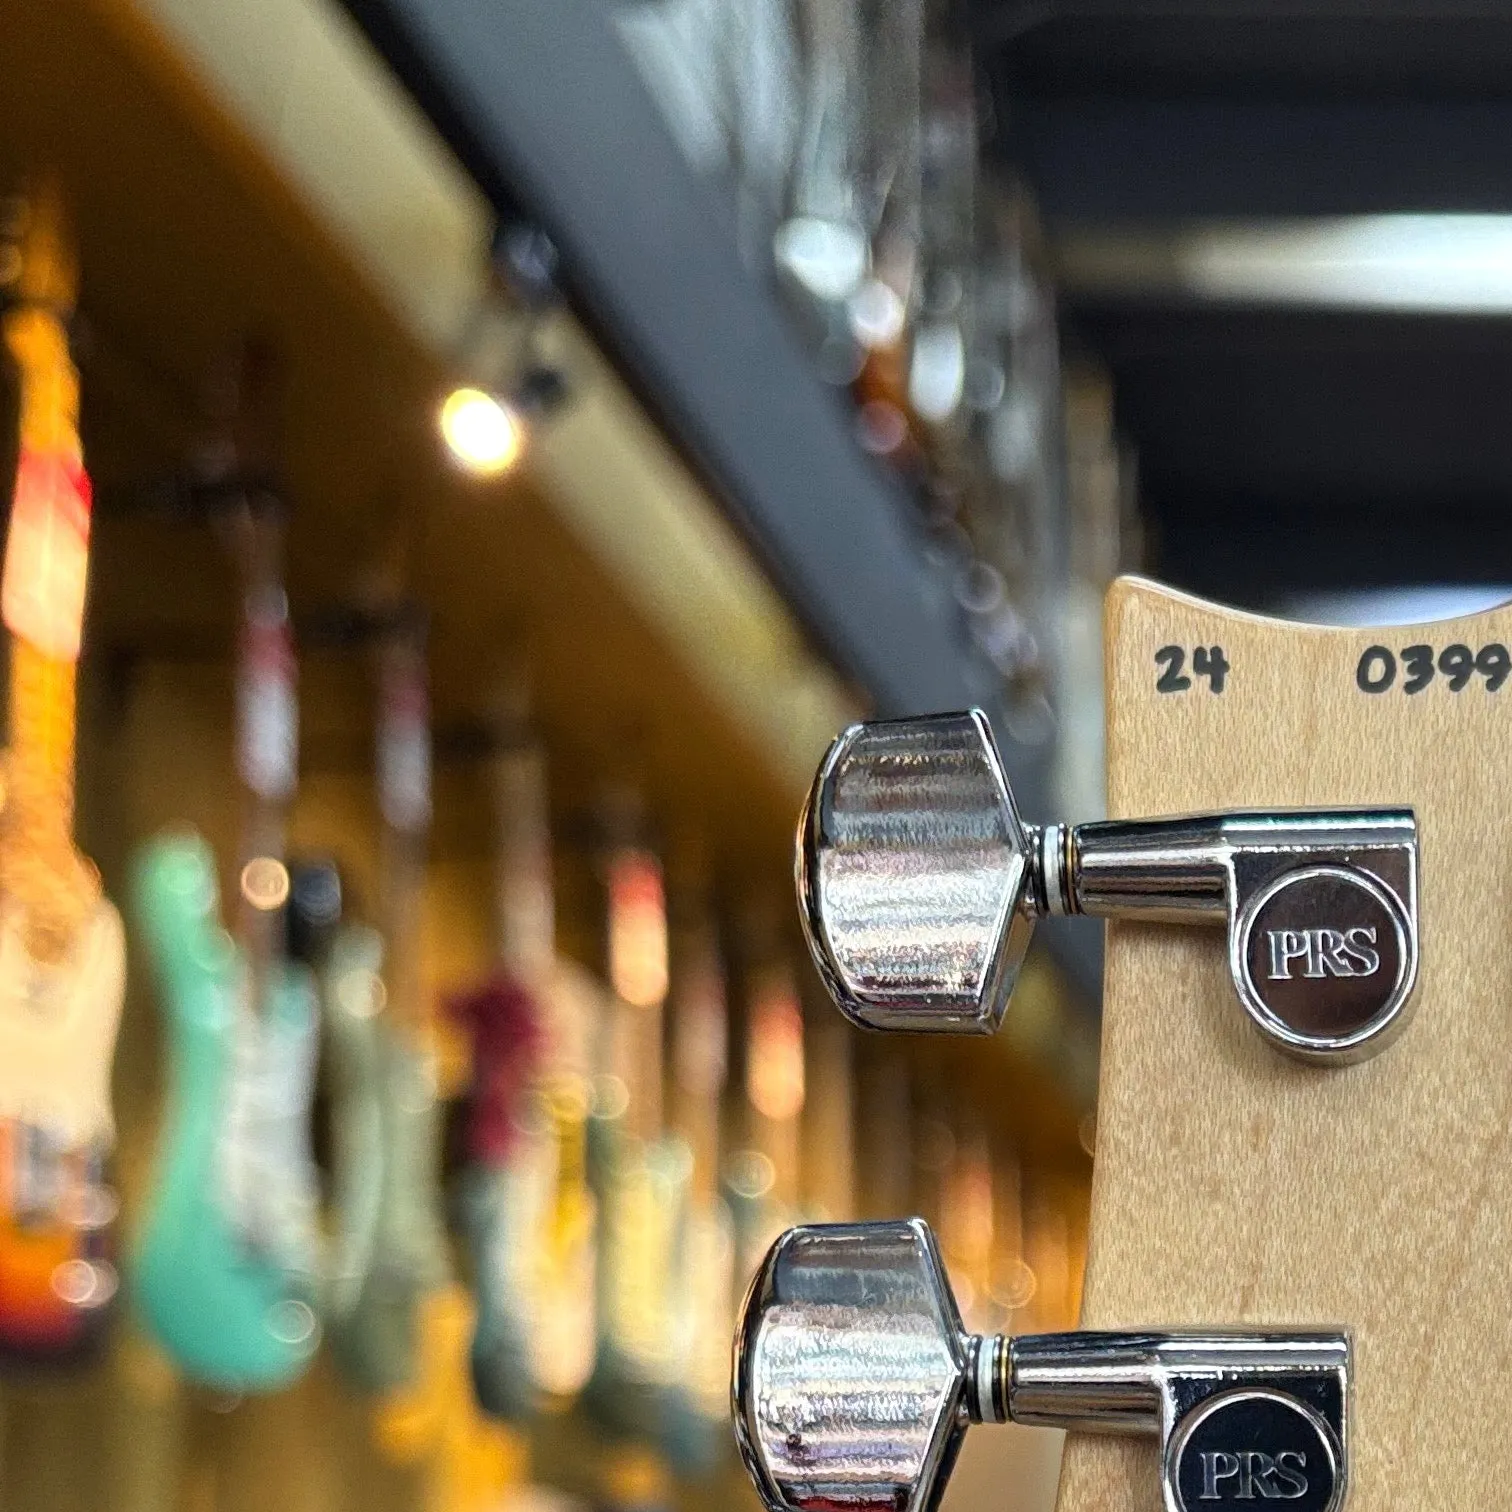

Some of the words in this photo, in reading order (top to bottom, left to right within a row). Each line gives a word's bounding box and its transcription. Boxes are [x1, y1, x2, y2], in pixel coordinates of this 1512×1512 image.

[1154, 644, 1230, 695] 24
[1266, 926, 1381, 980] PRS
[1198, 1451, 1309, 1500] PRS
